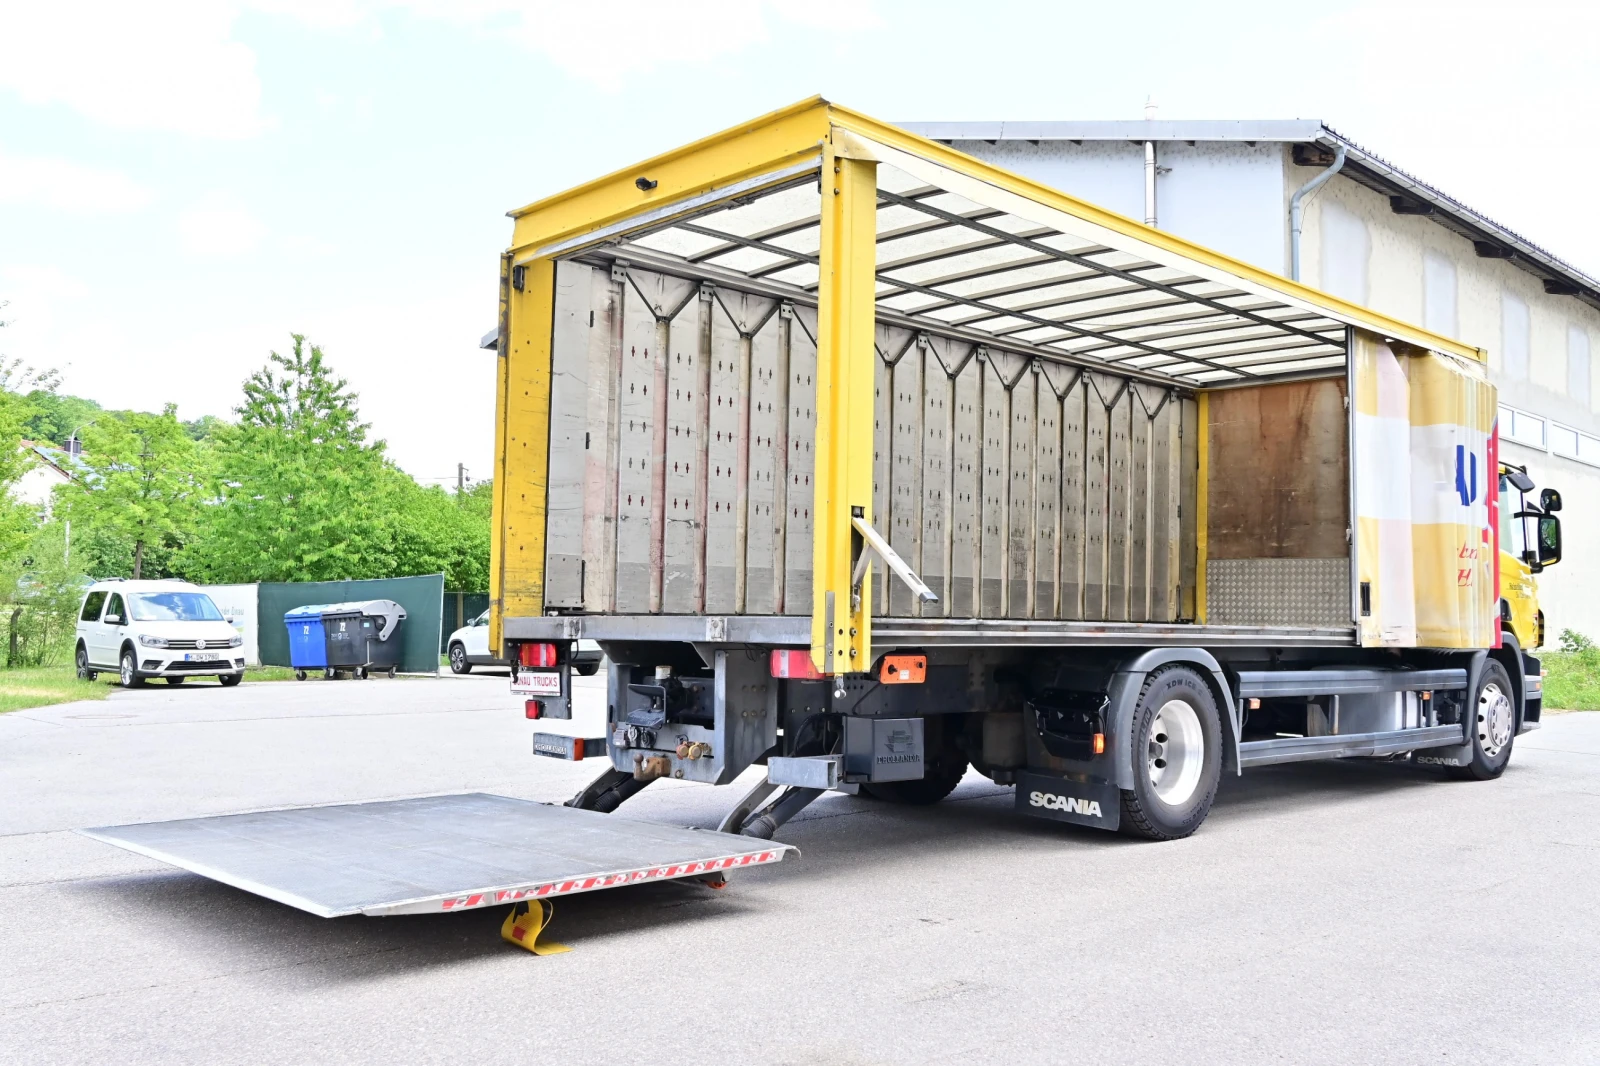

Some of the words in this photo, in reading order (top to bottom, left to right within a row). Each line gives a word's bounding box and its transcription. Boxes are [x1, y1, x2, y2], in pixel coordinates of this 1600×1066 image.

[303, 625, 310, 634] 72
[340, 622, 346, 631] 72
[513, 676, 531, 686] ONAU
[533, 676, 558, 687] TRUCKS
[1417, 756, 1460, 766] SCANIA
[1029, 791, 1103, 818] SCANIA
